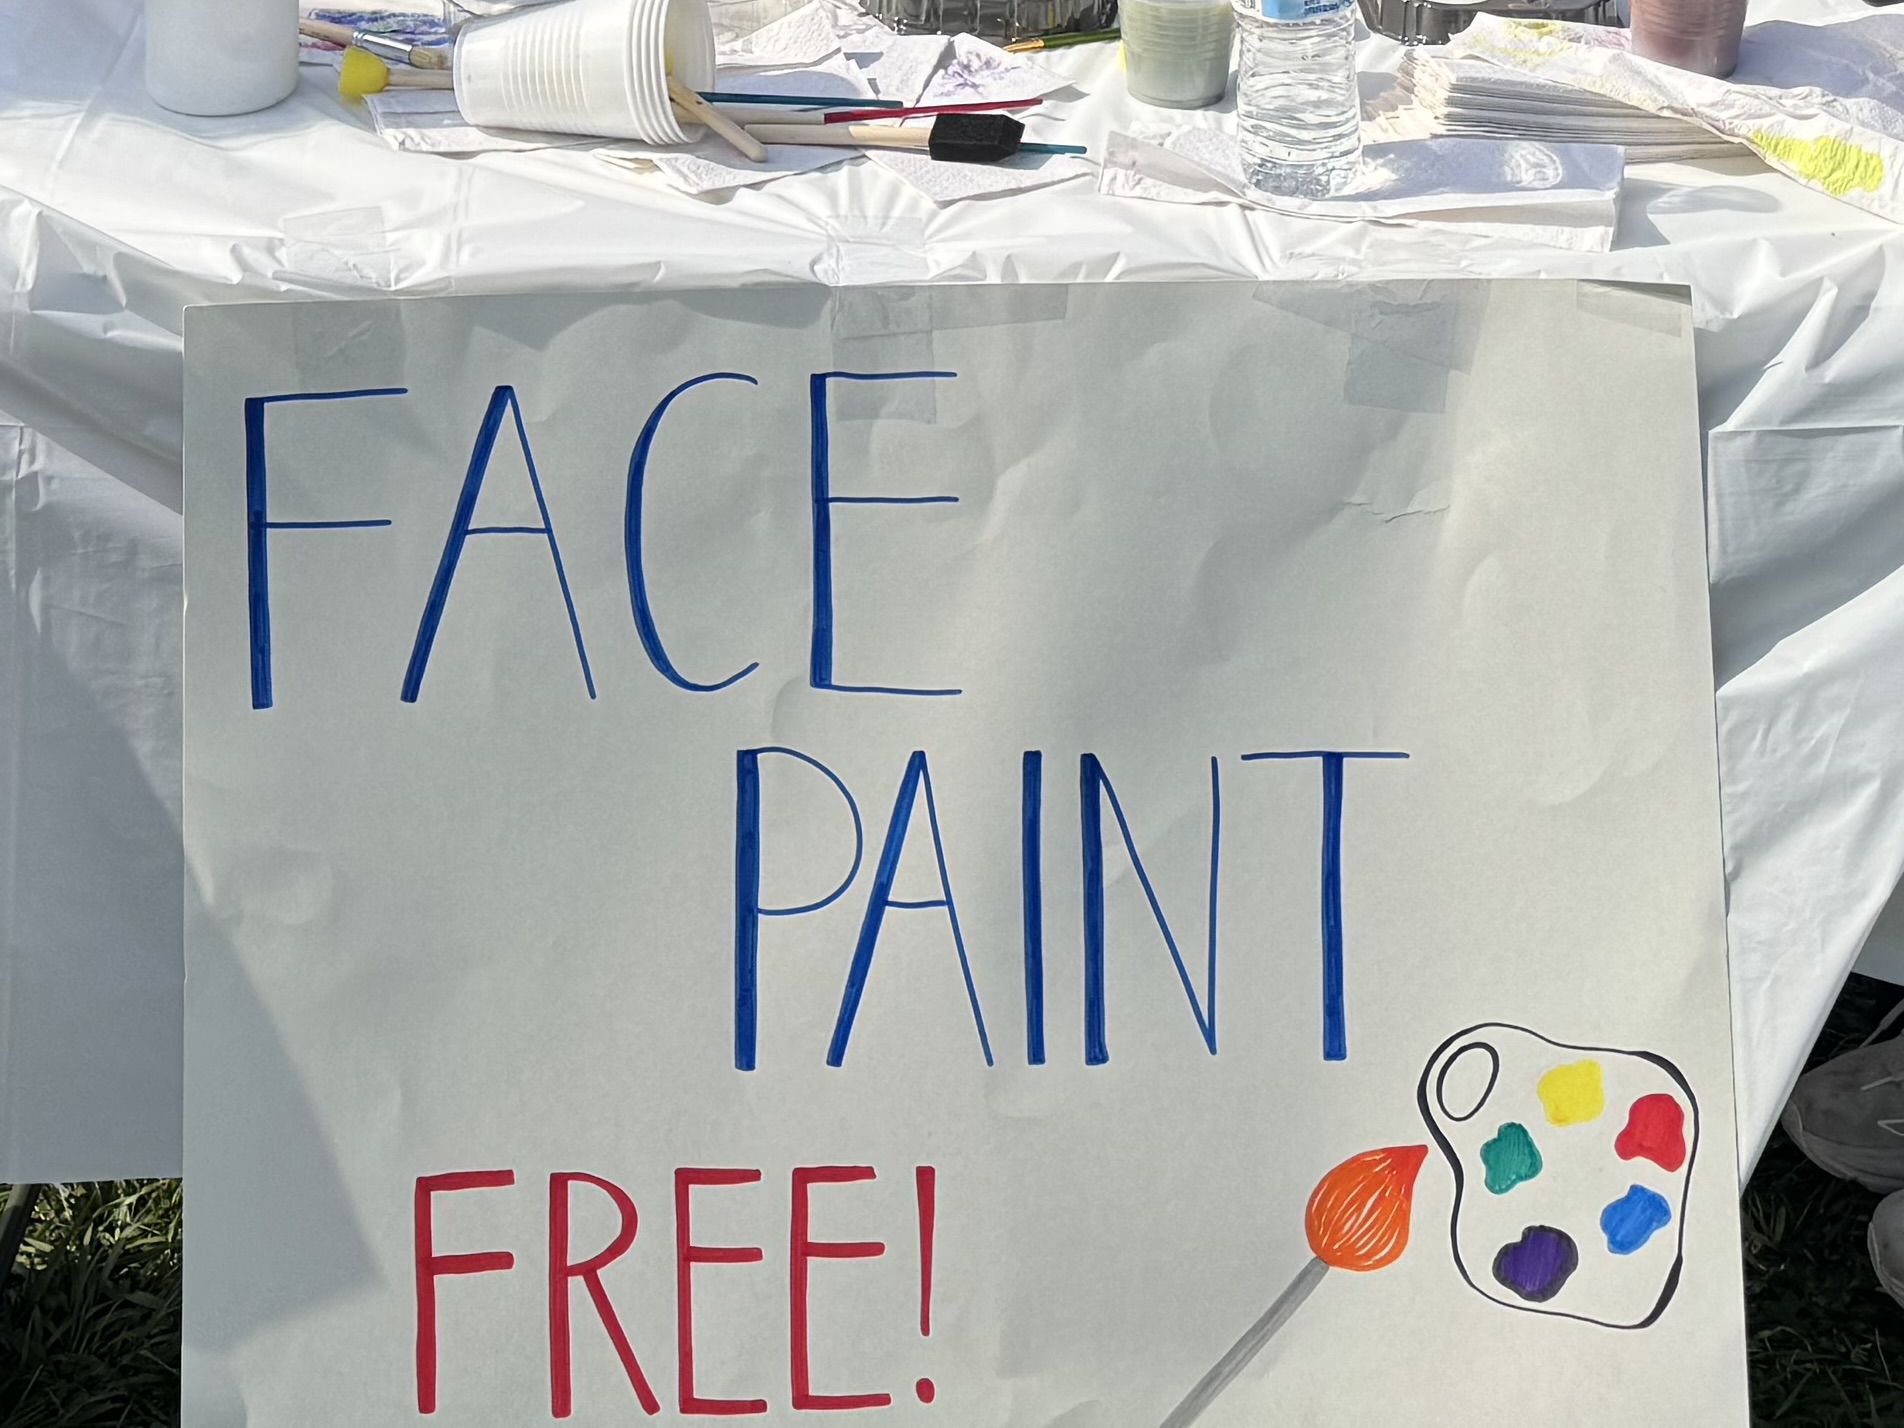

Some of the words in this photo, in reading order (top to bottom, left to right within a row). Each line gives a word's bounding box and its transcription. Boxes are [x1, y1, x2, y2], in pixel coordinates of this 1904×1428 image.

[244, 370, 963, 709] FACE
[733, 746, 1412, 1071] PAINT
[415, 1162, 940, 1420] FREE!
